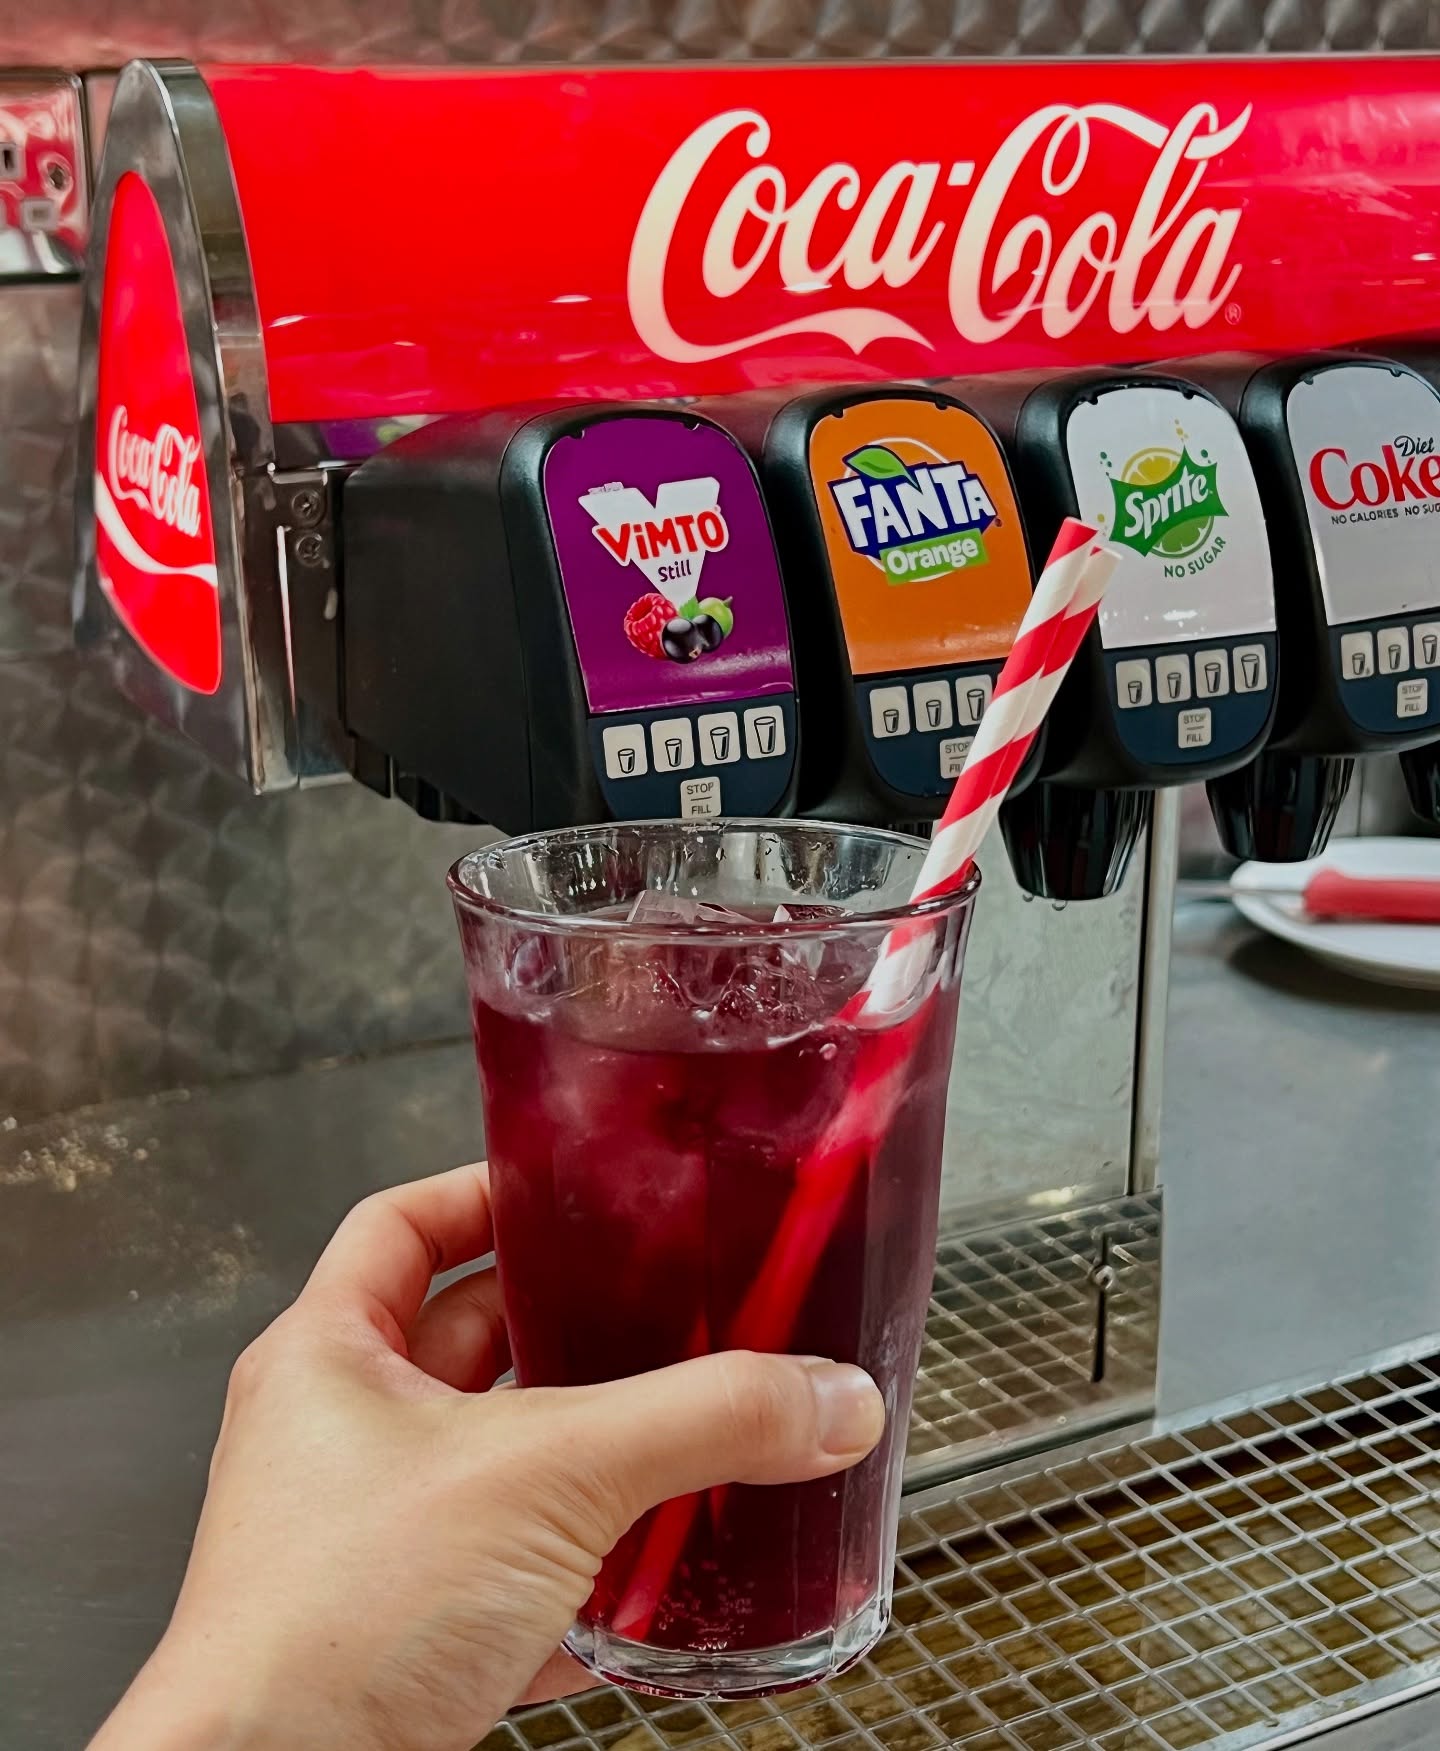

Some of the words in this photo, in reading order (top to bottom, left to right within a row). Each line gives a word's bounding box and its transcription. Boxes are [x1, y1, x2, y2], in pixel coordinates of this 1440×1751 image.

[627, 103, 1253, 363] Coca-Cola
[1394, 435, 1434, 456] Diet
[1309, 445, 1440, 511] Coke
[833, 465, 994, 548] FANTA
[1124, 466, 1209, 539] Sprite
[1331, 514, 1347, 524] NO
[1349, 508, 1399, 523] CALORIES
[1404, 505, 1420, 516] NO
[887, 537, 979, 575] Orange
[1164, 565, 1185, 578] NO
[1188, 536, 1226, 575] SUGAR
[658, 559, 691, 582] Still
[1184, 712, 1206, 724] STOP
[1187, 733, 1203, 744] FILL
[687, 782, 713, 795] STOP
[692, 804, 712, 815] FILL
